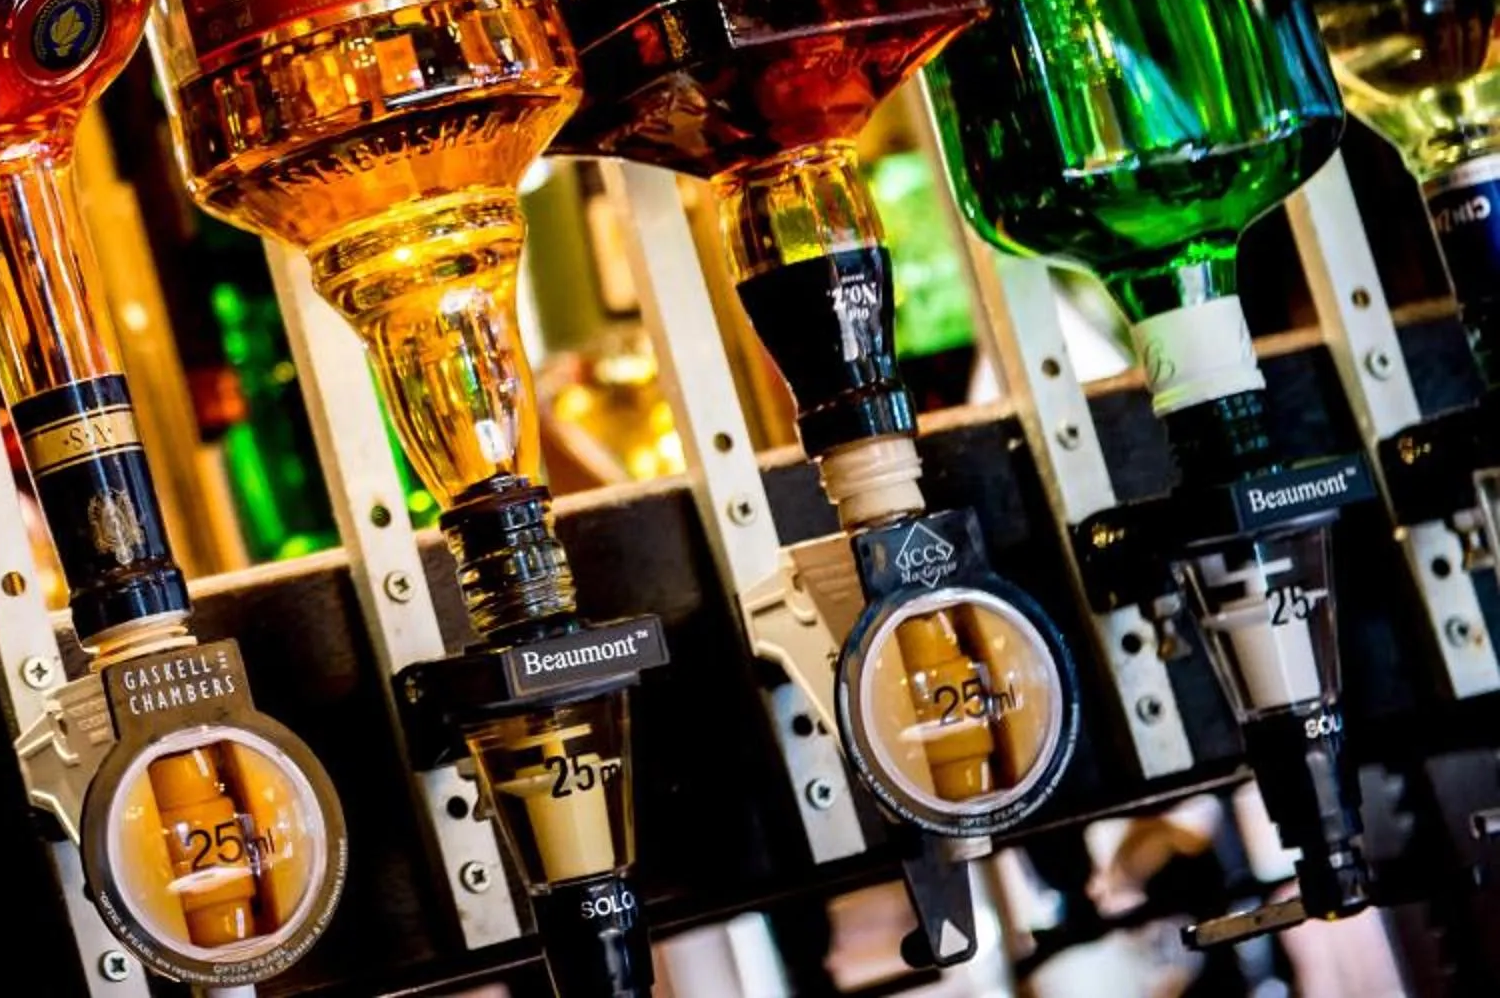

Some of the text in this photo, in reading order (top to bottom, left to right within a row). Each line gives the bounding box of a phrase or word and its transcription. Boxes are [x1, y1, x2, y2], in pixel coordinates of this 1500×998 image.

[1271, 586, 1313, 626] 25
[124, 660, 212, 692] GASKELL
[129, 674, 237, 717] CHAMBERS
[933, 677, 986, 727] 25
[544, 754, 596, 800] 25
[186, 820, 246, 871] 25
[581, 889, 637, 919] SOLO
